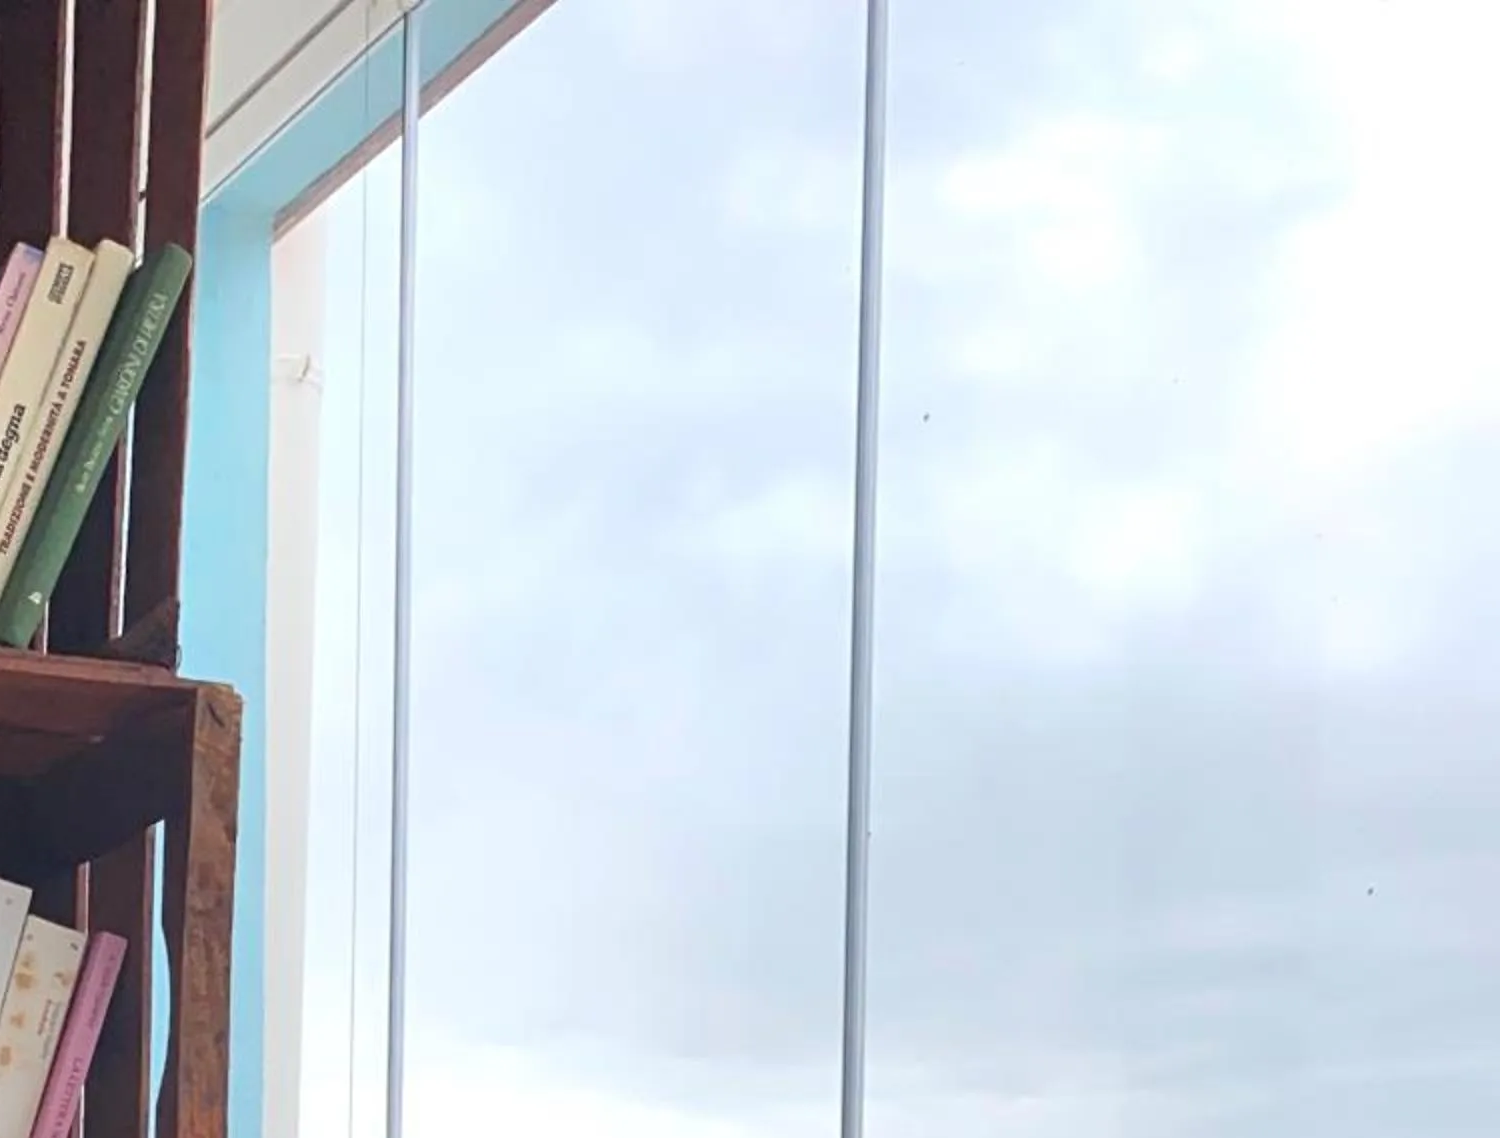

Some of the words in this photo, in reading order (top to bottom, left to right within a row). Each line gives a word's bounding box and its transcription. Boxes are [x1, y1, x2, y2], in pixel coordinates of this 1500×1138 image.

[25, 471, 36, 483] E
[58, 387, 68, 400] A
[63, 339, 88, 391] TONARA
